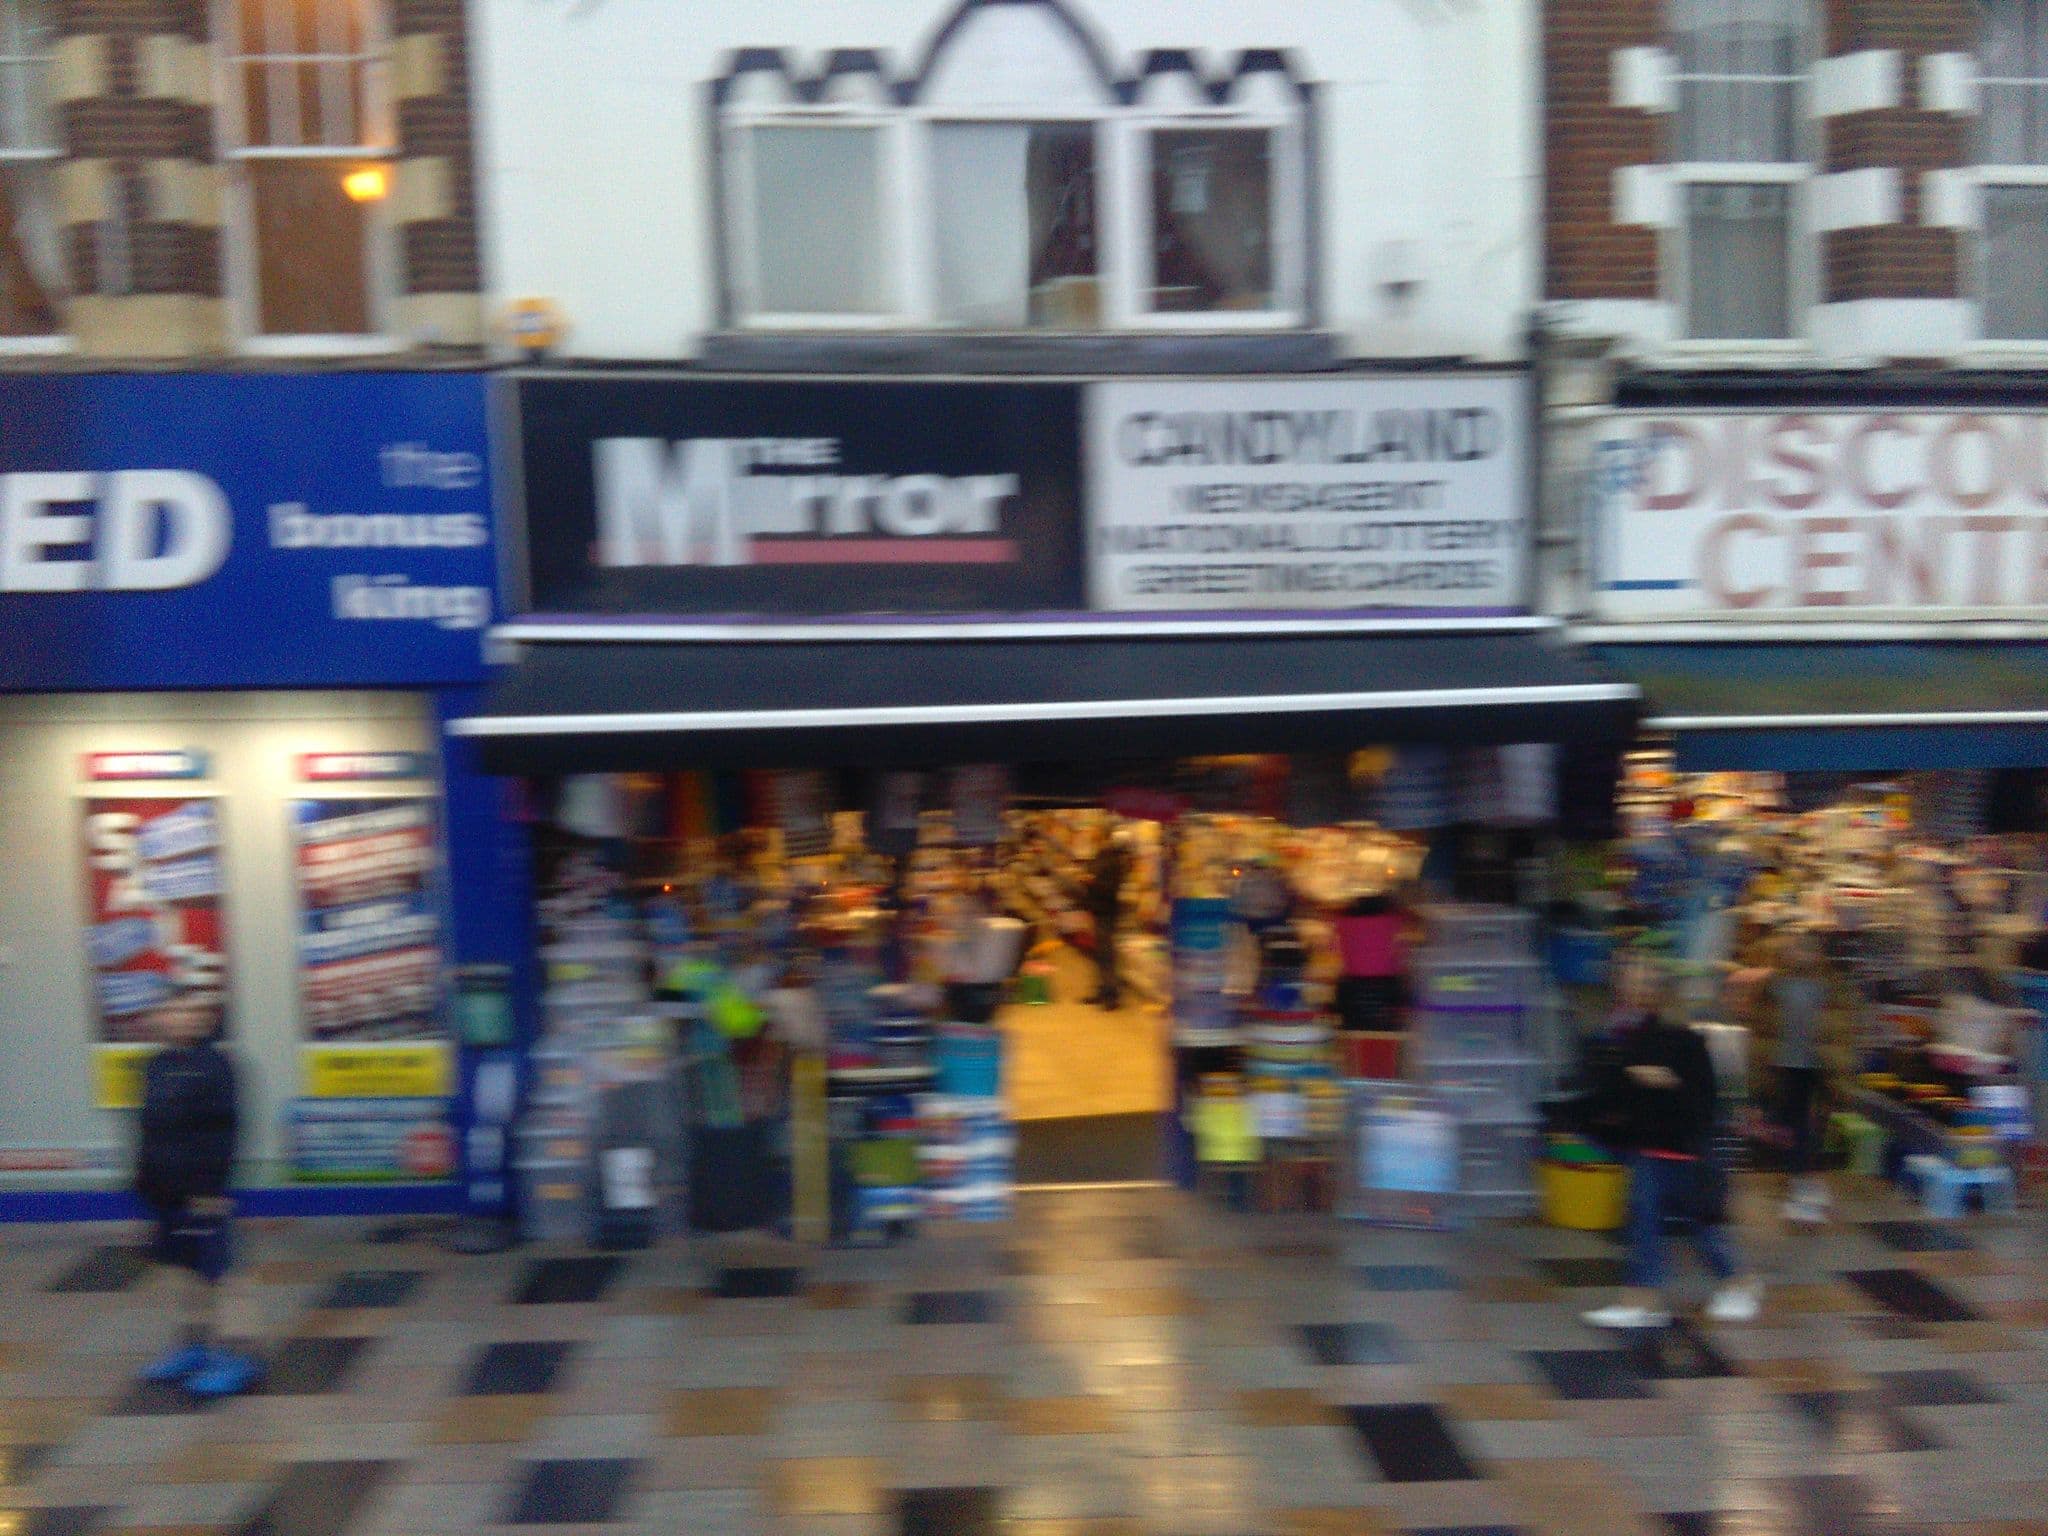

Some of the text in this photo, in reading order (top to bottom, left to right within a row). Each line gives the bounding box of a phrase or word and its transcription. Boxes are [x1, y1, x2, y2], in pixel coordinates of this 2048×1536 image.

[1120, 407, 1496, 466] CANDYLAND
[1173, 479, 1446, 514] NEWSAGENT
[268, 502, 488, 549] bonus
[1102, 517, 1521, 554] NATIONAL LOTTERY
[1348, 558, 1496, 591] CARDS
[332, 574, 489, 630] king
